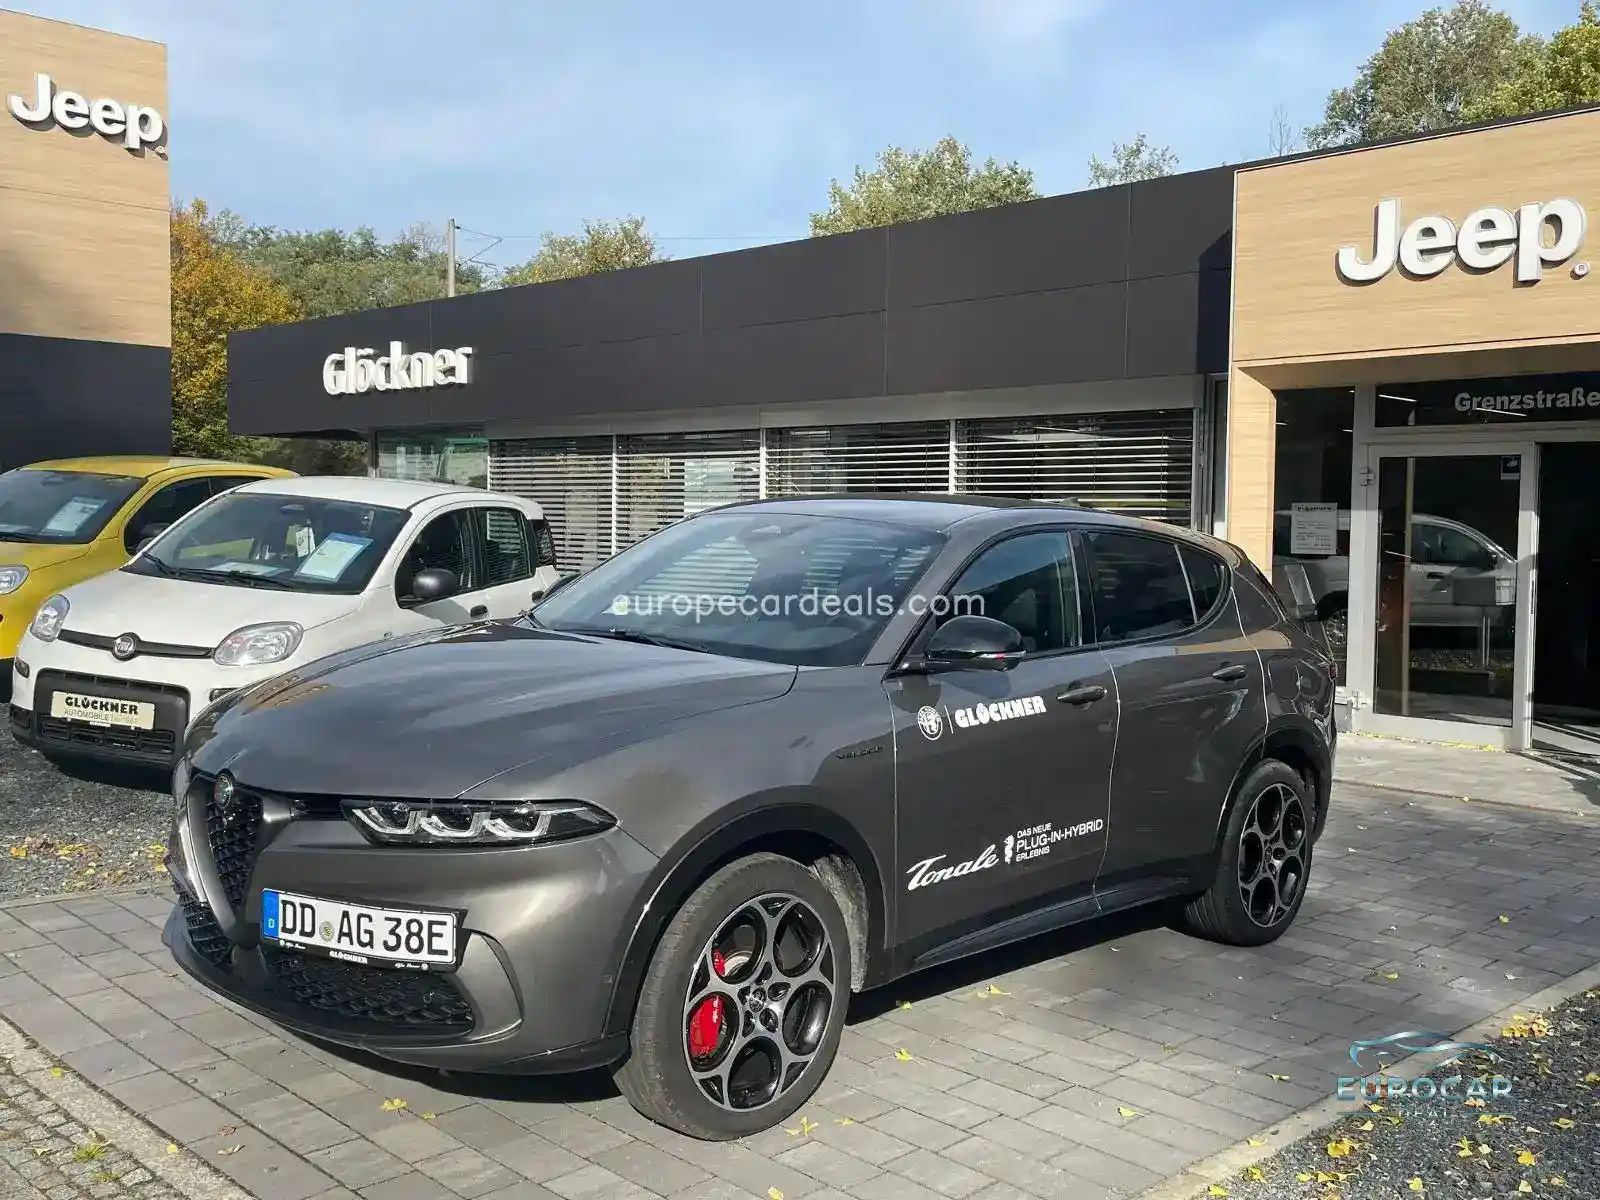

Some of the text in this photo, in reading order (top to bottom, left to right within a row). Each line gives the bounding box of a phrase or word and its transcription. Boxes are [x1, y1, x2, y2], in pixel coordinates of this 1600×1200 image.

[9, 72, 163, 149] Jeep
[1337, 197, 1587, 282] Jeep
[322, 340, 473, 396] Glöckner
[1454, 386, 1600, 412] Grenzstraße
[954, 695, 1047, 728] GLÖCKNER
[1016, 818, 1104, 853] PLUG-IN-HYBRID
[1017, 822, 1052, 839] DAS NEUE
[906, 843, 1000, 891] Tonale
[1015, 846, 1050, 862] ERLEBNIS
[280, 899, 449, 956] DD AG 38E
